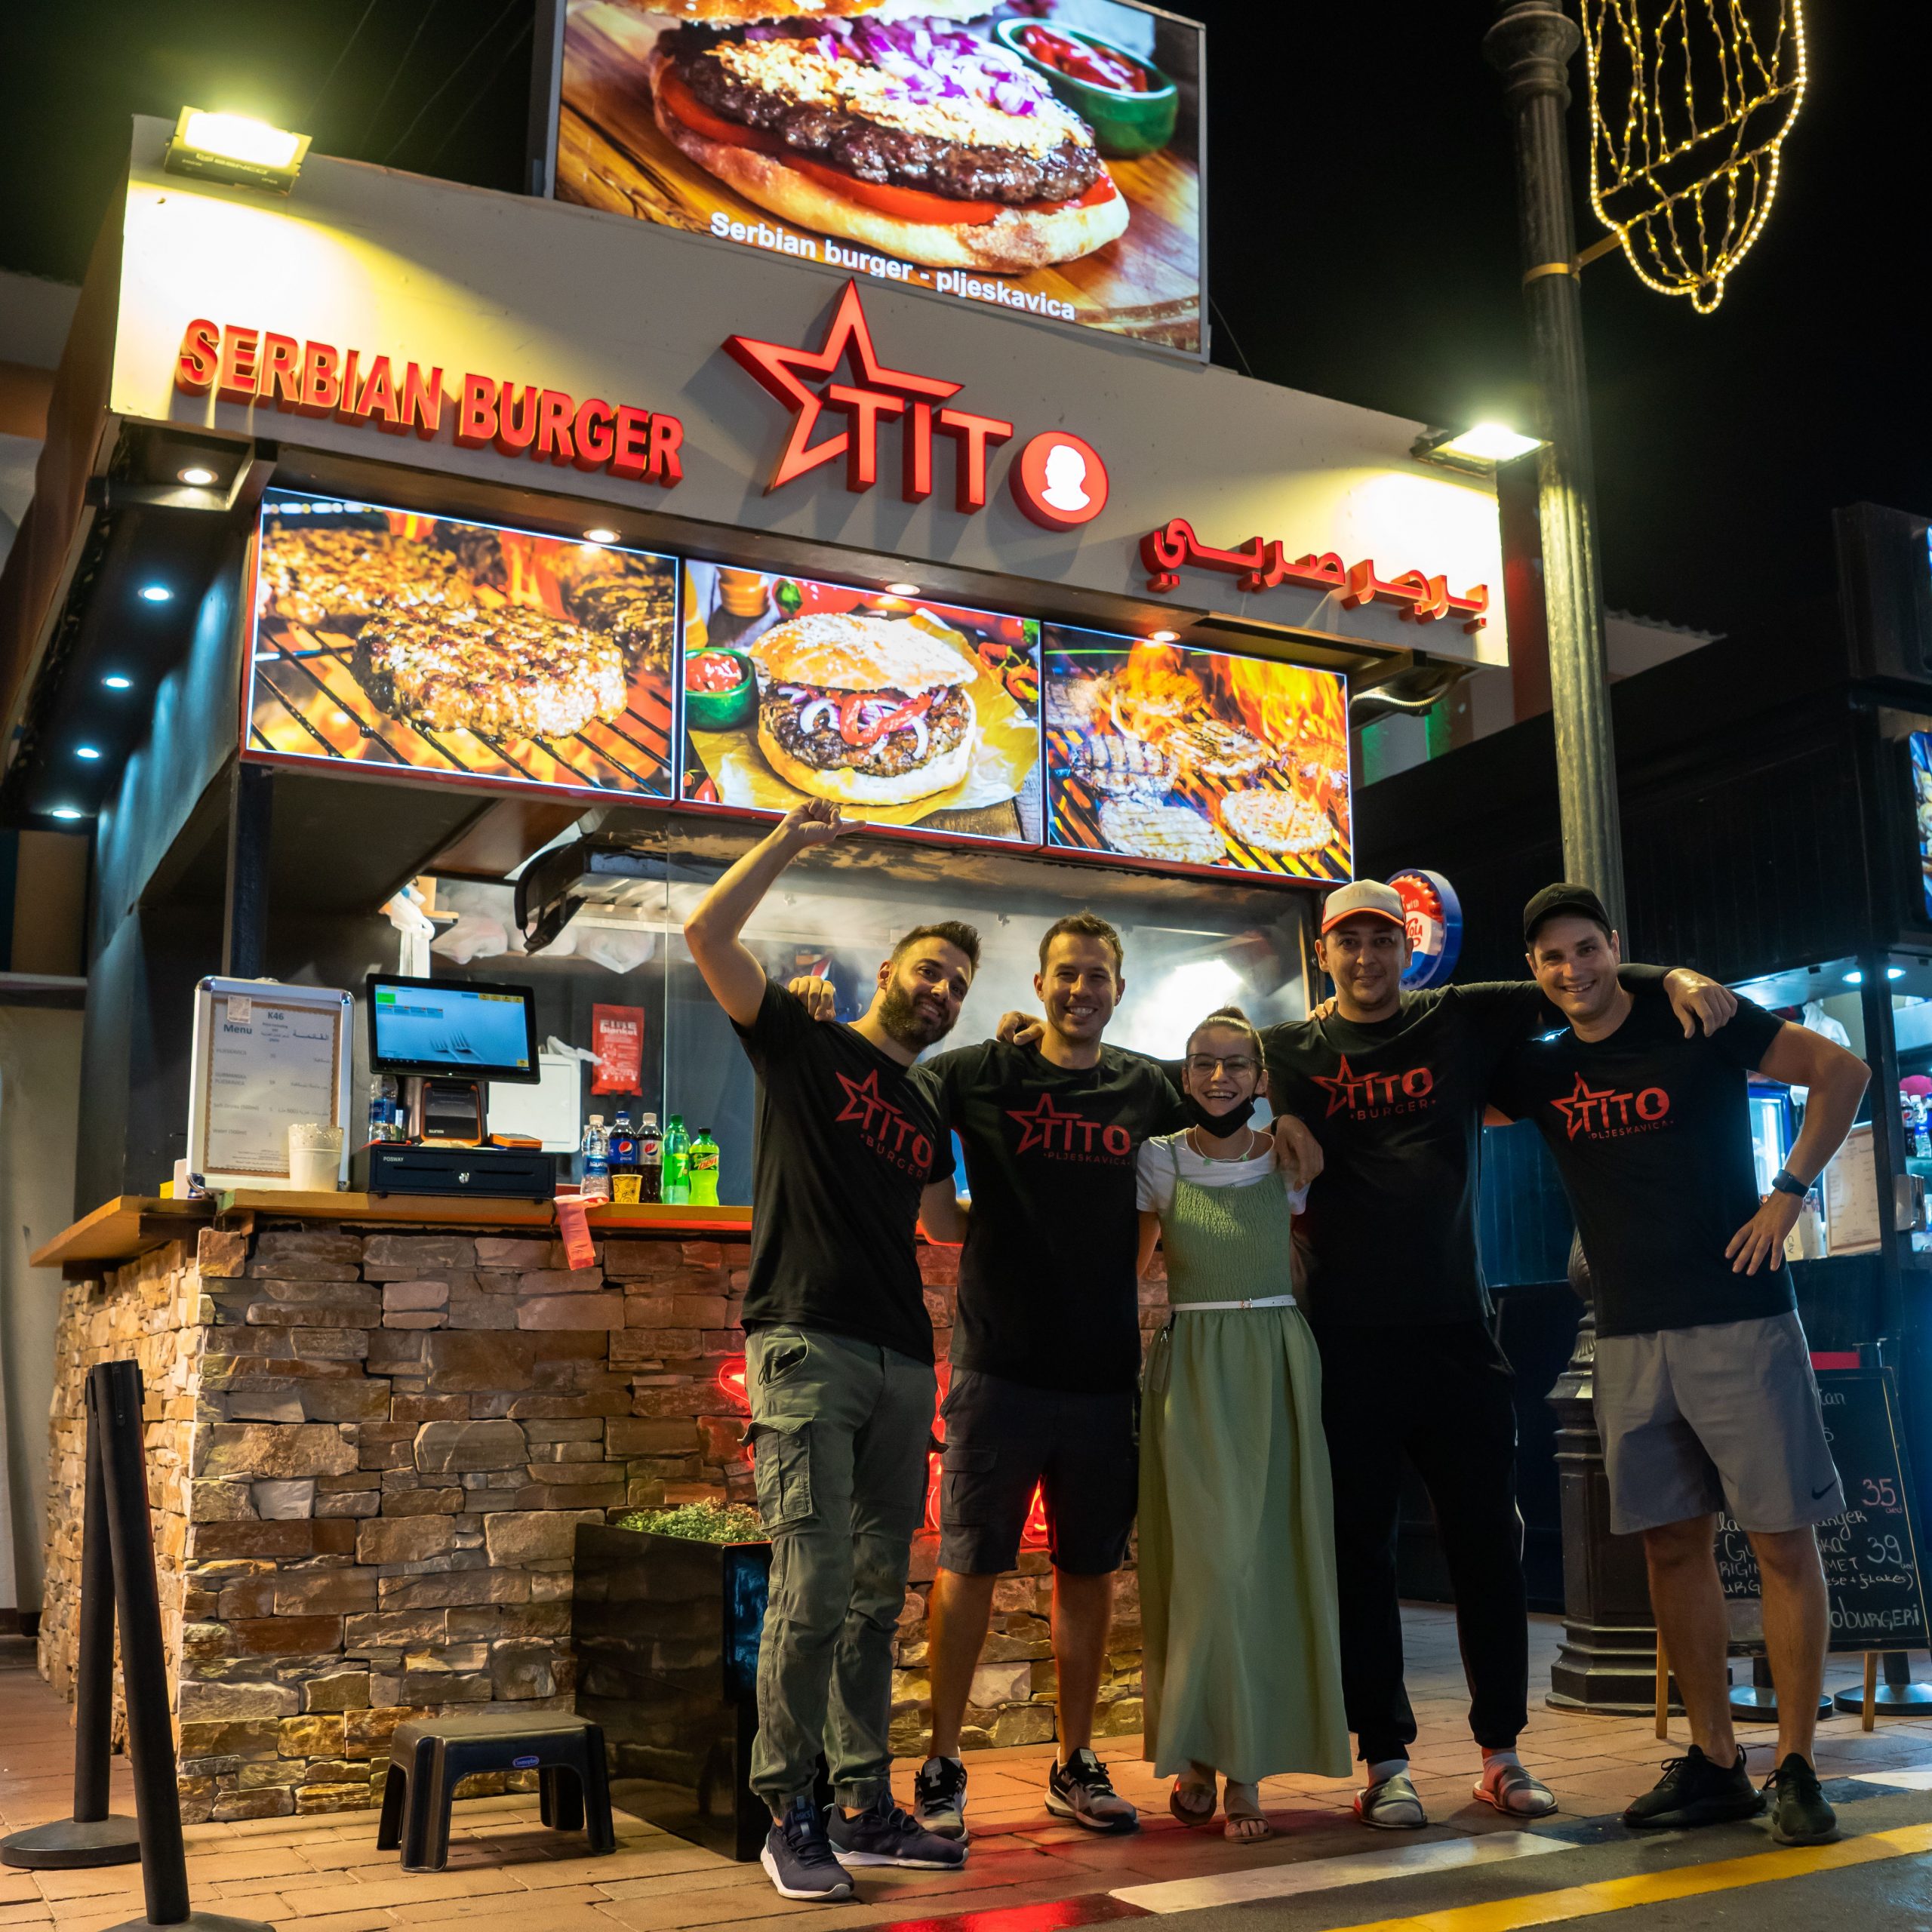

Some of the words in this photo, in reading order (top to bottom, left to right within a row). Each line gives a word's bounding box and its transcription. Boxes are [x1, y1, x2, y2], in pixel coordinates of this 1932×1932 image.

[710, 211, 817, 259] Serbian
[824, 238, 914, 280] burger
[937, 267, 1076, 321] pljeskavica
[177, 318, 444, 441] SERBIAN
[453, 372, 685, 489] BURGER
[1140, 518, 1346, 594] صربي
[1341, 558, 1489, 635] برجر
[223, 1023, 253, 1035] Menu
[267, 1011, 285, 1020] K46
[1358, 1099, 1429, 1121] BURGER
[1591, 1118, 1670, 1140] PLJESKAVICA
[866, 1136, 925, 1180] BURGER
[1047, 1152, 1128, 1167] PLJESKAVICA
[1862, 1478, 1897, 1507] 35
[1866, 1535, 1903, 1564] 39
